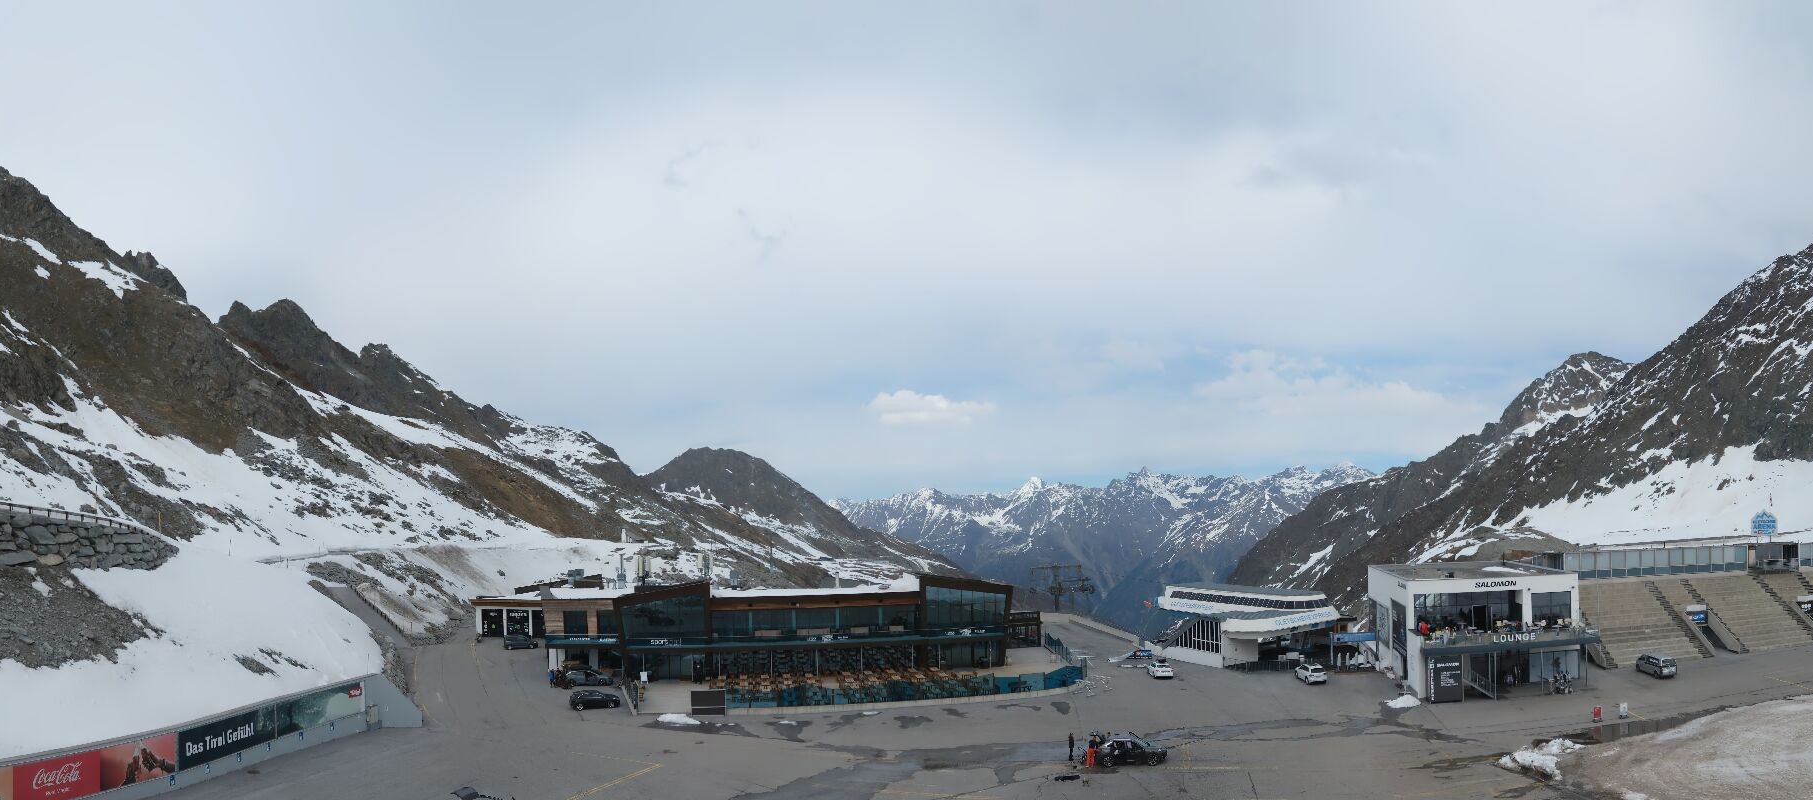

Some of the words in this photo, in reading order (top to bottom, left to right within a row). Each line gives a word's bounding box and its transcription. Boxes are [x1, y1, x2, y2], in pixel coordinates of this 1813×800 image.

[1475, 580, 1517, 588] SALOMON
[1493, 632, 1536, 643] LOUNGE
[185, 741, 204, 757] Das
[205, 731, 226, 751] Tirol
[227, 722, 255, 744] Gefühl
[32, 761, 83, 790] Coca-Cola
